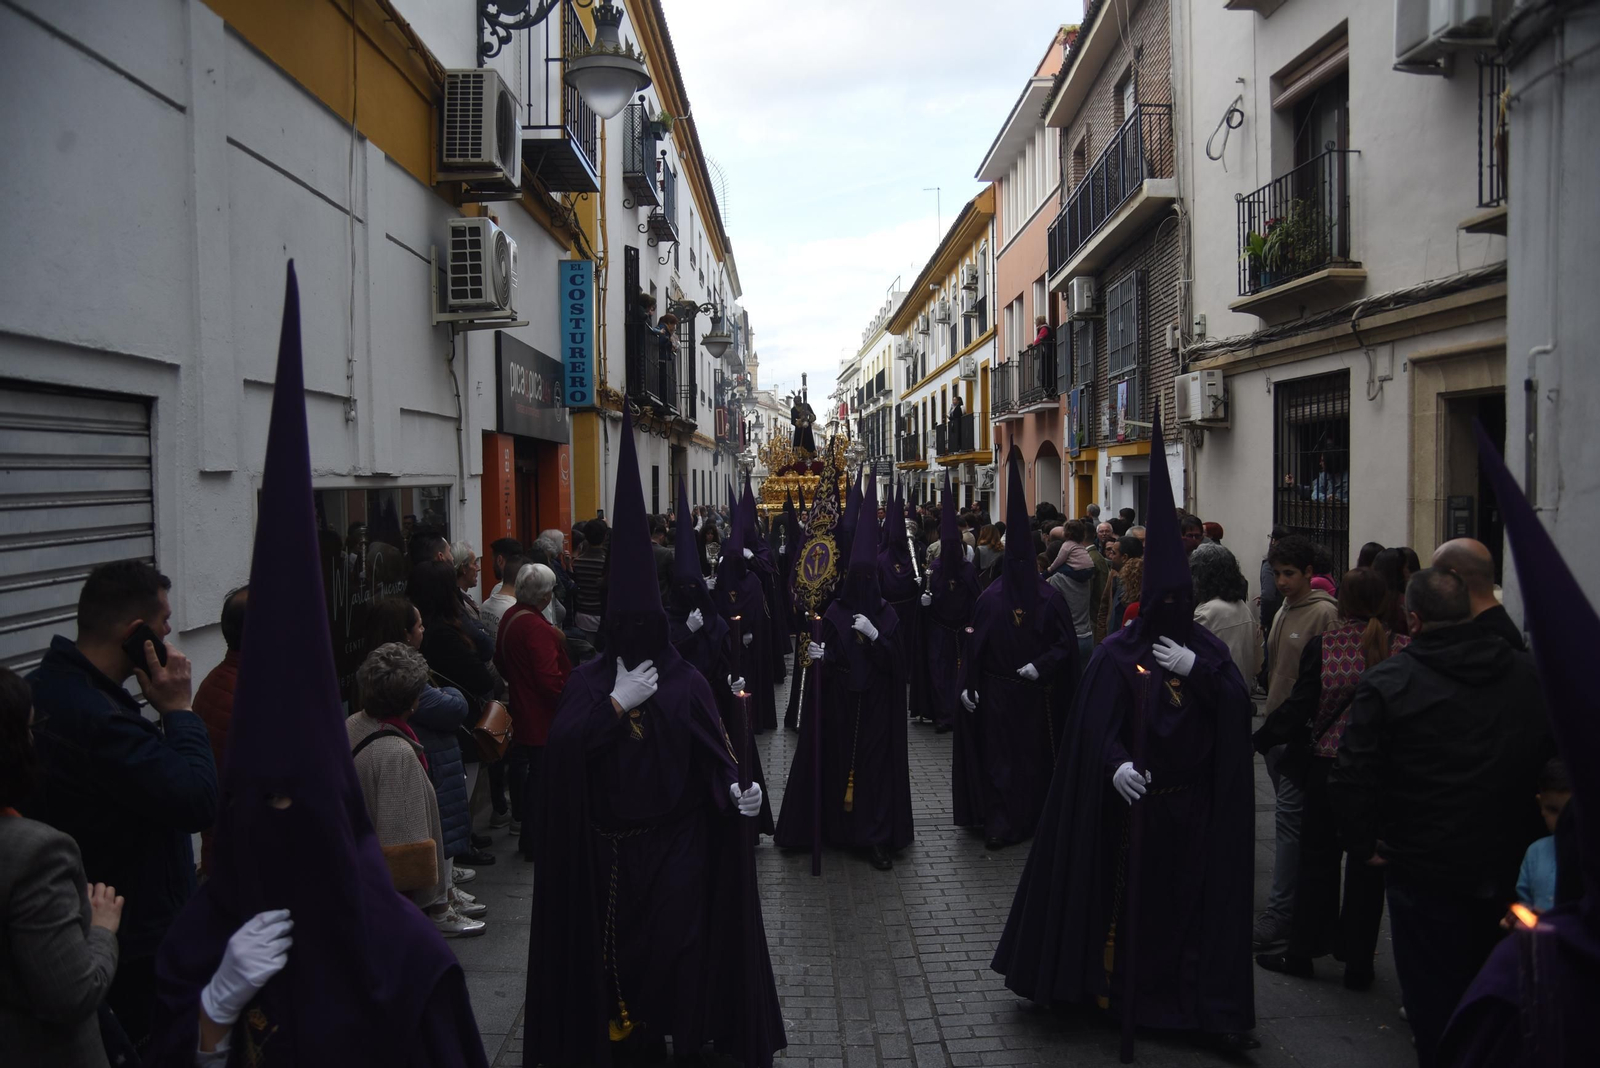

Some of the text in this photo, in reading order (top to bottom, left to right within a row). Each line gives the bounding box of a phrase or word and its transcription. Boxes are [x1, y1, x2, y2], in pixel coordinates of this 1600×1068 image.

[570, 263, 584, 271] EL
[568, 273, 587, 403] COSTURERO
[332, 545, 371, 638] Marta
